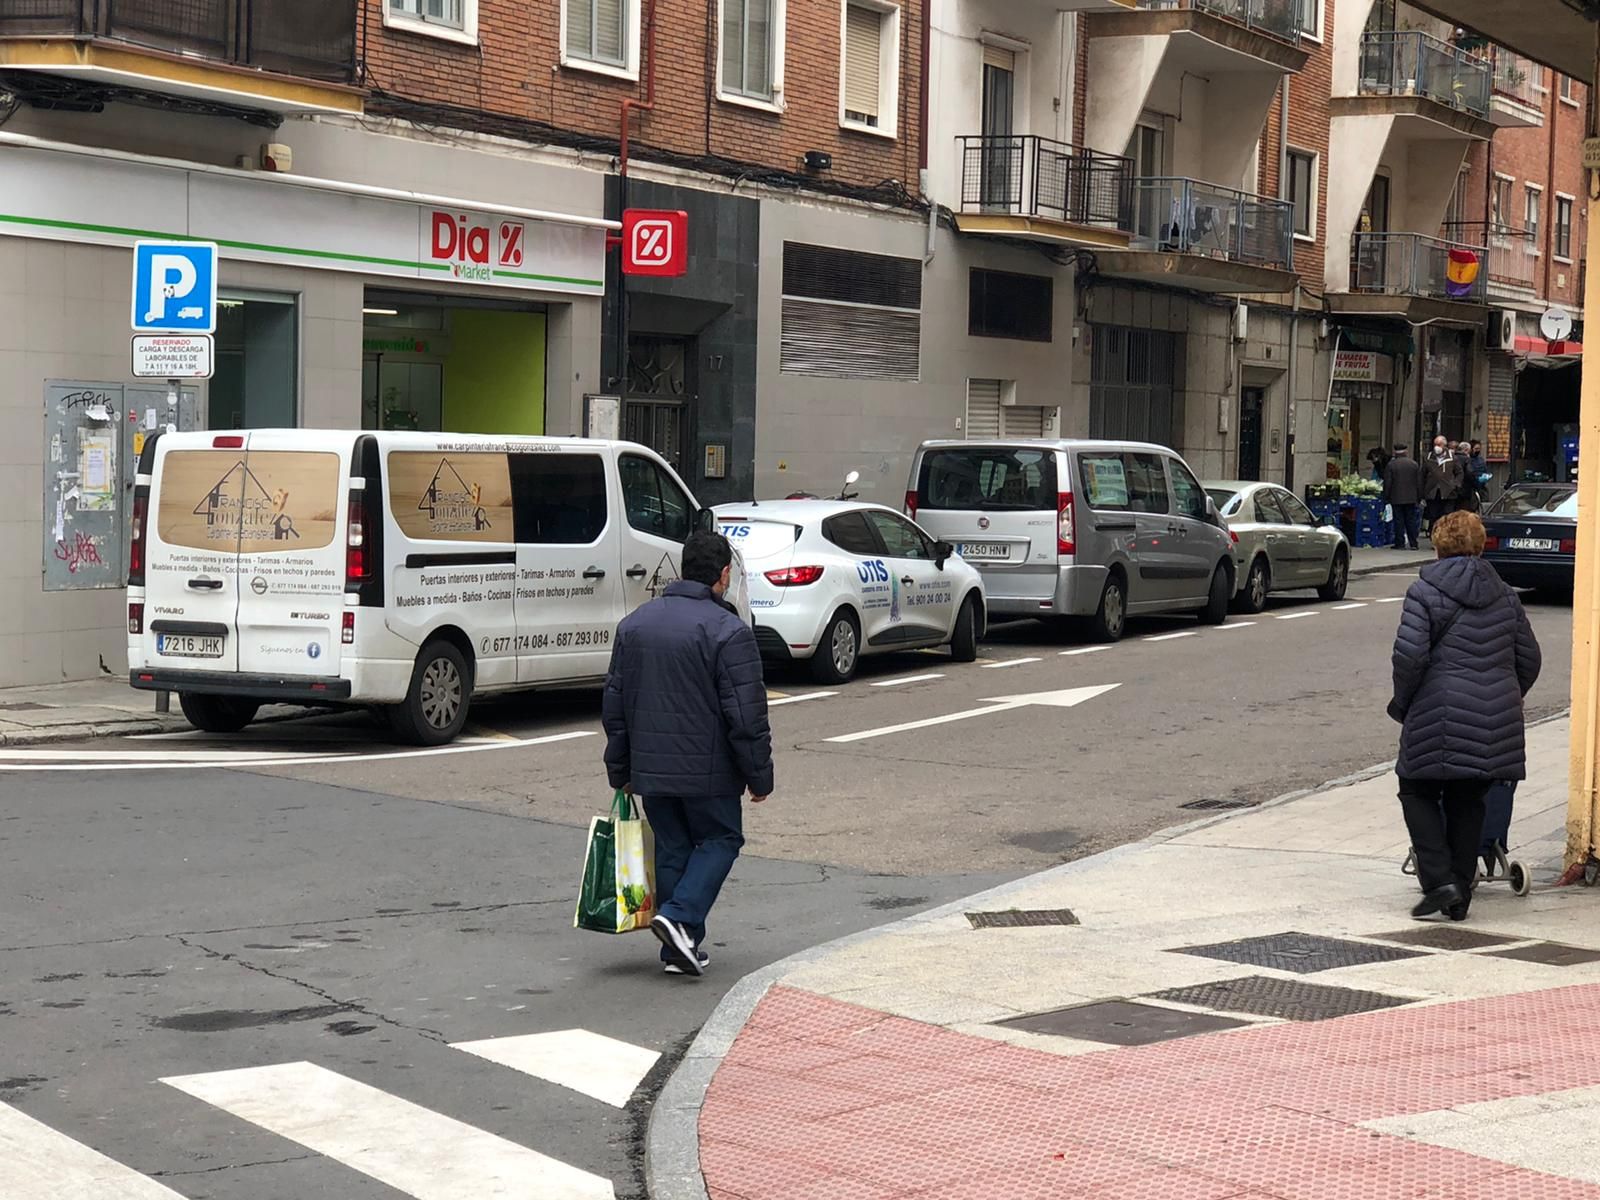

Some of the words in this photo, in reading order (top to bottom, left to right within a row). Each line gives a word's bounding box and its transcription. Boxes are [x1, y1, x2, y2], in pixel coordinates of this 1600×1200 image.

[431, 211, 490, 264] Dia
[457, 264, 491, 281] Market
[150, 253, 197, 319] P
[709, 355, 723, 369] 17
[1344, 361, 1370, 369] FRUTAS
[718, 525, 751, 537] TIS
[963, 544, 987, 554] 2450
[989, 544, 1008, 555] HNW
[169, 553, 189, 562] Puertas
[190, 555, 217, 563] interiores
[222, 556, 252, 564] exteriores
[257, 556, 281, 564] Tarimas
[285, 557, 314, 566] Armarios
[152, 563, 173, 571] Muebles
[178, 564, 198, 572] medida
[225, 565, 249, 574] Cocinas
[253, 566, 273, 575] Frisos
[282, 568, 304, 576] techos
[857, 559, 889, 584] OTIS
[420, 574, 447, 587] Puertas
[447, 572, 479, 584] interiores
[479, 574, 484, 585] y
[485, 570, 516, 582] exteriores
[520, 569, 545, 580] Tarimas
[548, 568, 576, 578] Armarios
[396, 595, 425, 608] Muebles
[426, 597, 431, 605] a
[432, 592, 458, 605] medida
[462, 591, 483, 603] Baños
[487, 589, 512, 601] Cocinas
[516, 588, 536, 599] Frisos
[536, 589, 545, 598] en
[545, 586, 566, 598] techos
[566, 588, 571, 599] y
[571, 585, 594, 597] paredes
[153, 606, 185, 615] VIVARO
[164, 637, 195, 652] 7216
[198, 639, 220, 652] JHK
[493, 636, 511, 652] 677
[513, 635, 529, 650] 174
[531, 634, 549, 649] 084
[556, 632, 573, 647] 687
[574, 631, 591, 646] 293
[593, 630, 610, 644] 019
